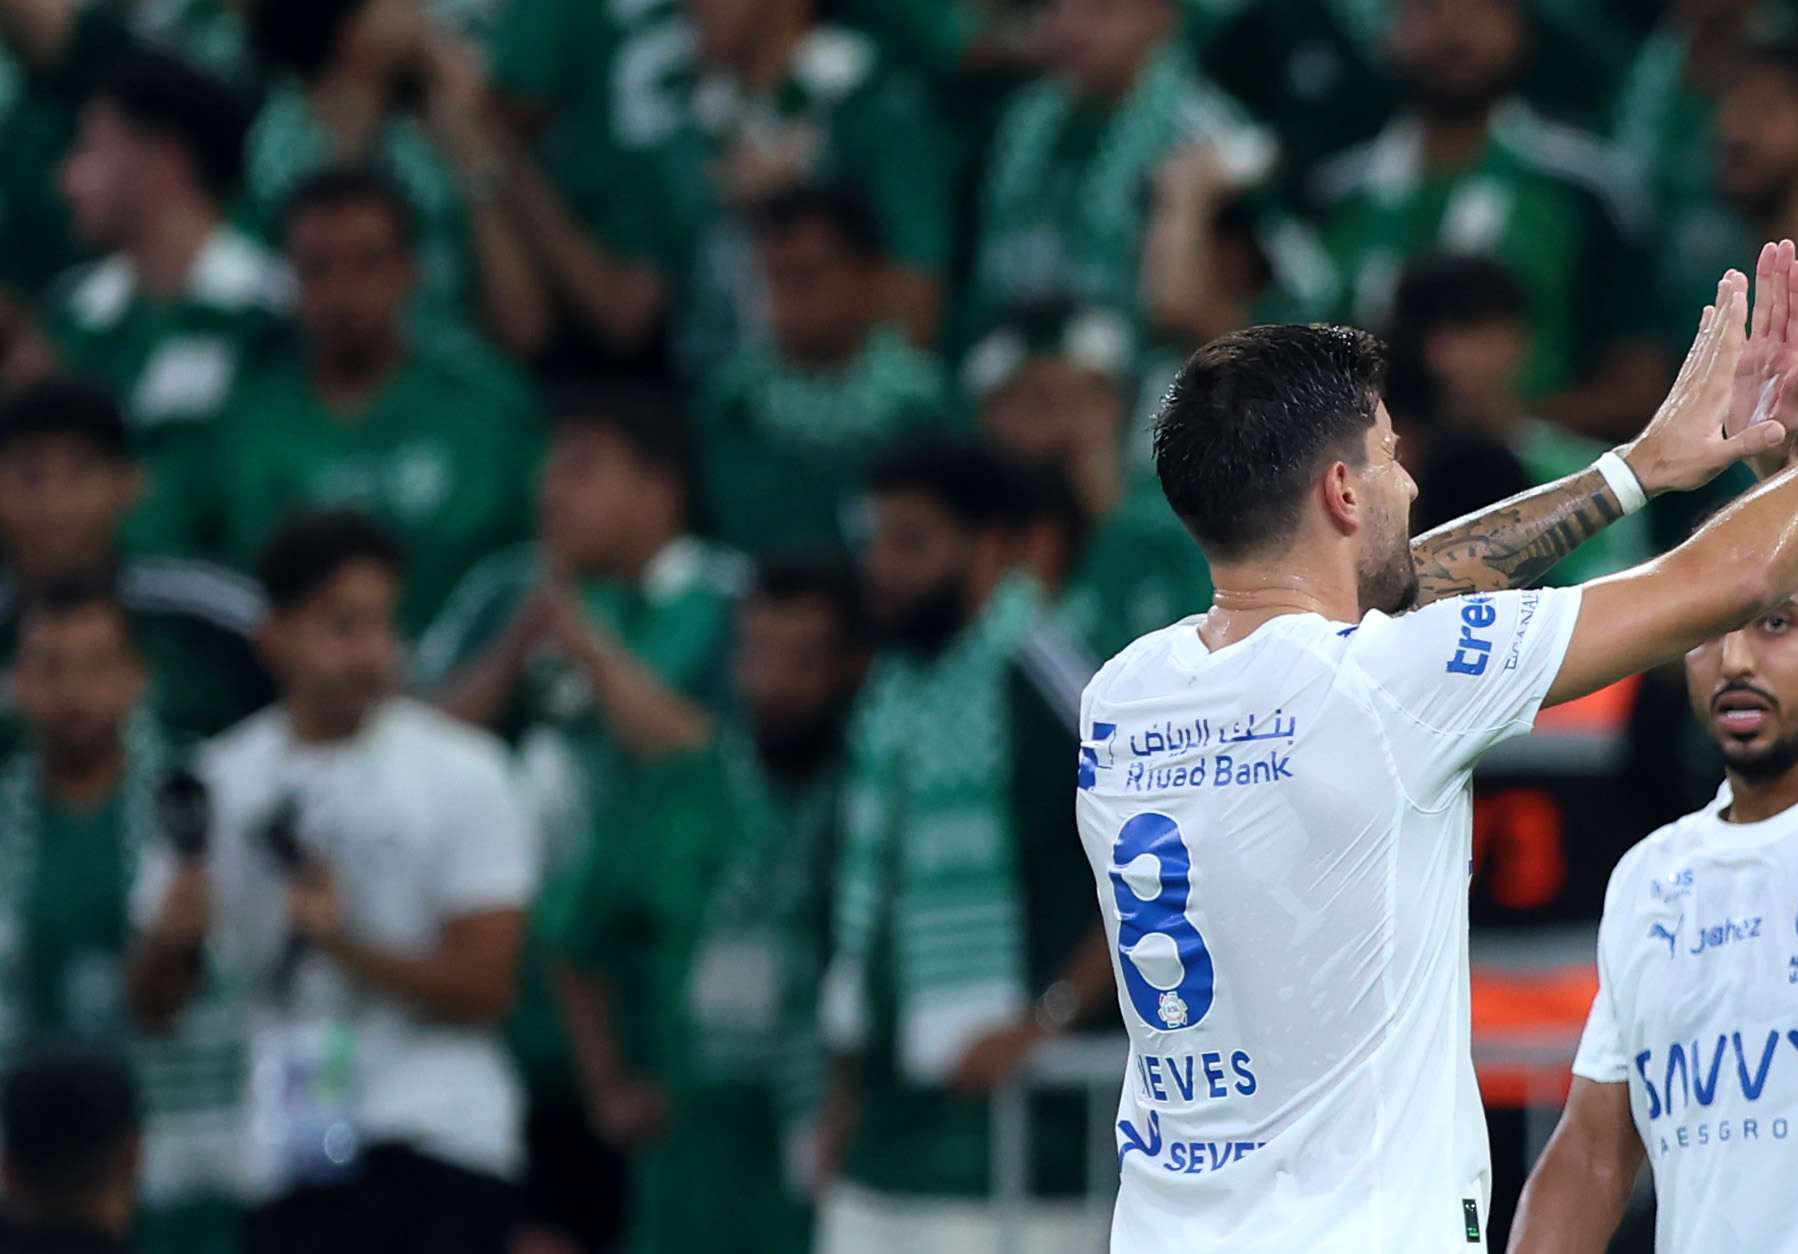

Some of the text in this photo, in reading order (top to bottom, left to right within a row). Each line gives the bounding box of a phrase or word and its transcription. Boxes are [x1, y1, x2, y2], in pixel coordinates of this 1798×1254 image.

[1130, 719, 1210, 758] الرياض
[1213, 751, 1294, 786] Bank
[1110, 812, 1215, 1031] 8
[1138, 1050, 1257, 1101] EVES
[1163, 1142, 1268, 1174] SEVE
